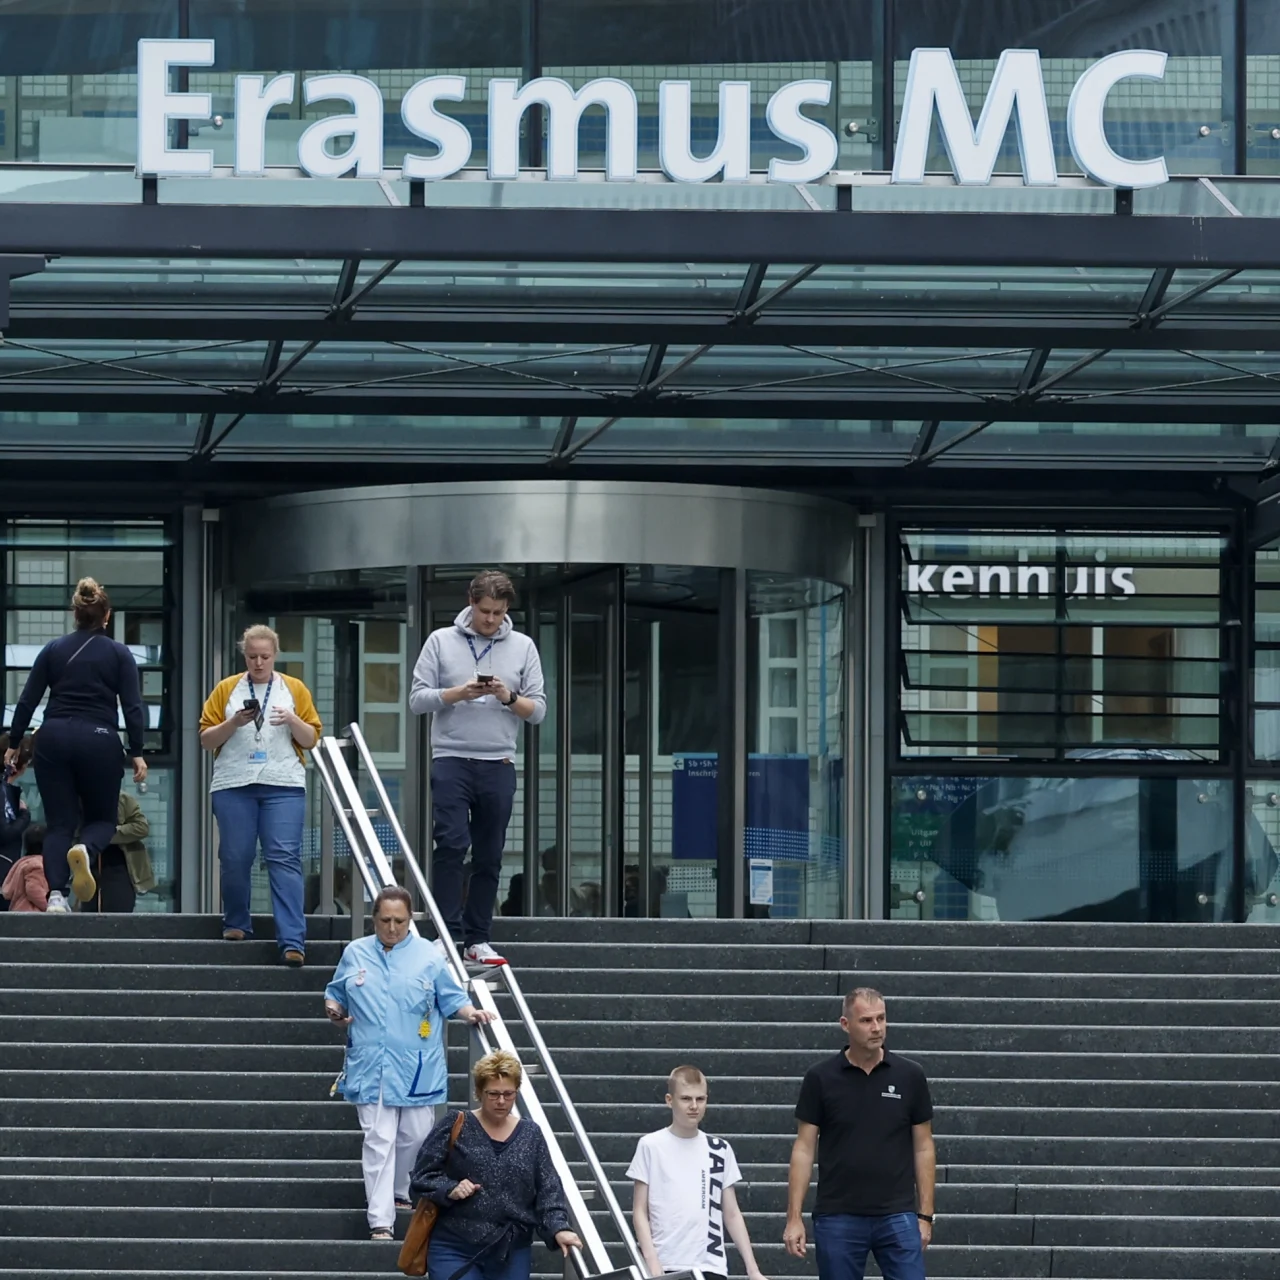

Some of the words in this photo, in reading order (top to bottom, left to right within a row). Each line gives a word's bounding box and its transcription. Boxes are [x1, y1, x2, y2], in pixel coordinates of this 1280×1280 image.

[137, 38, 838, 184] Erasmus
[891, 47, 1168, 189] MC
[705, 1135, 728, 1257] BALLIN
